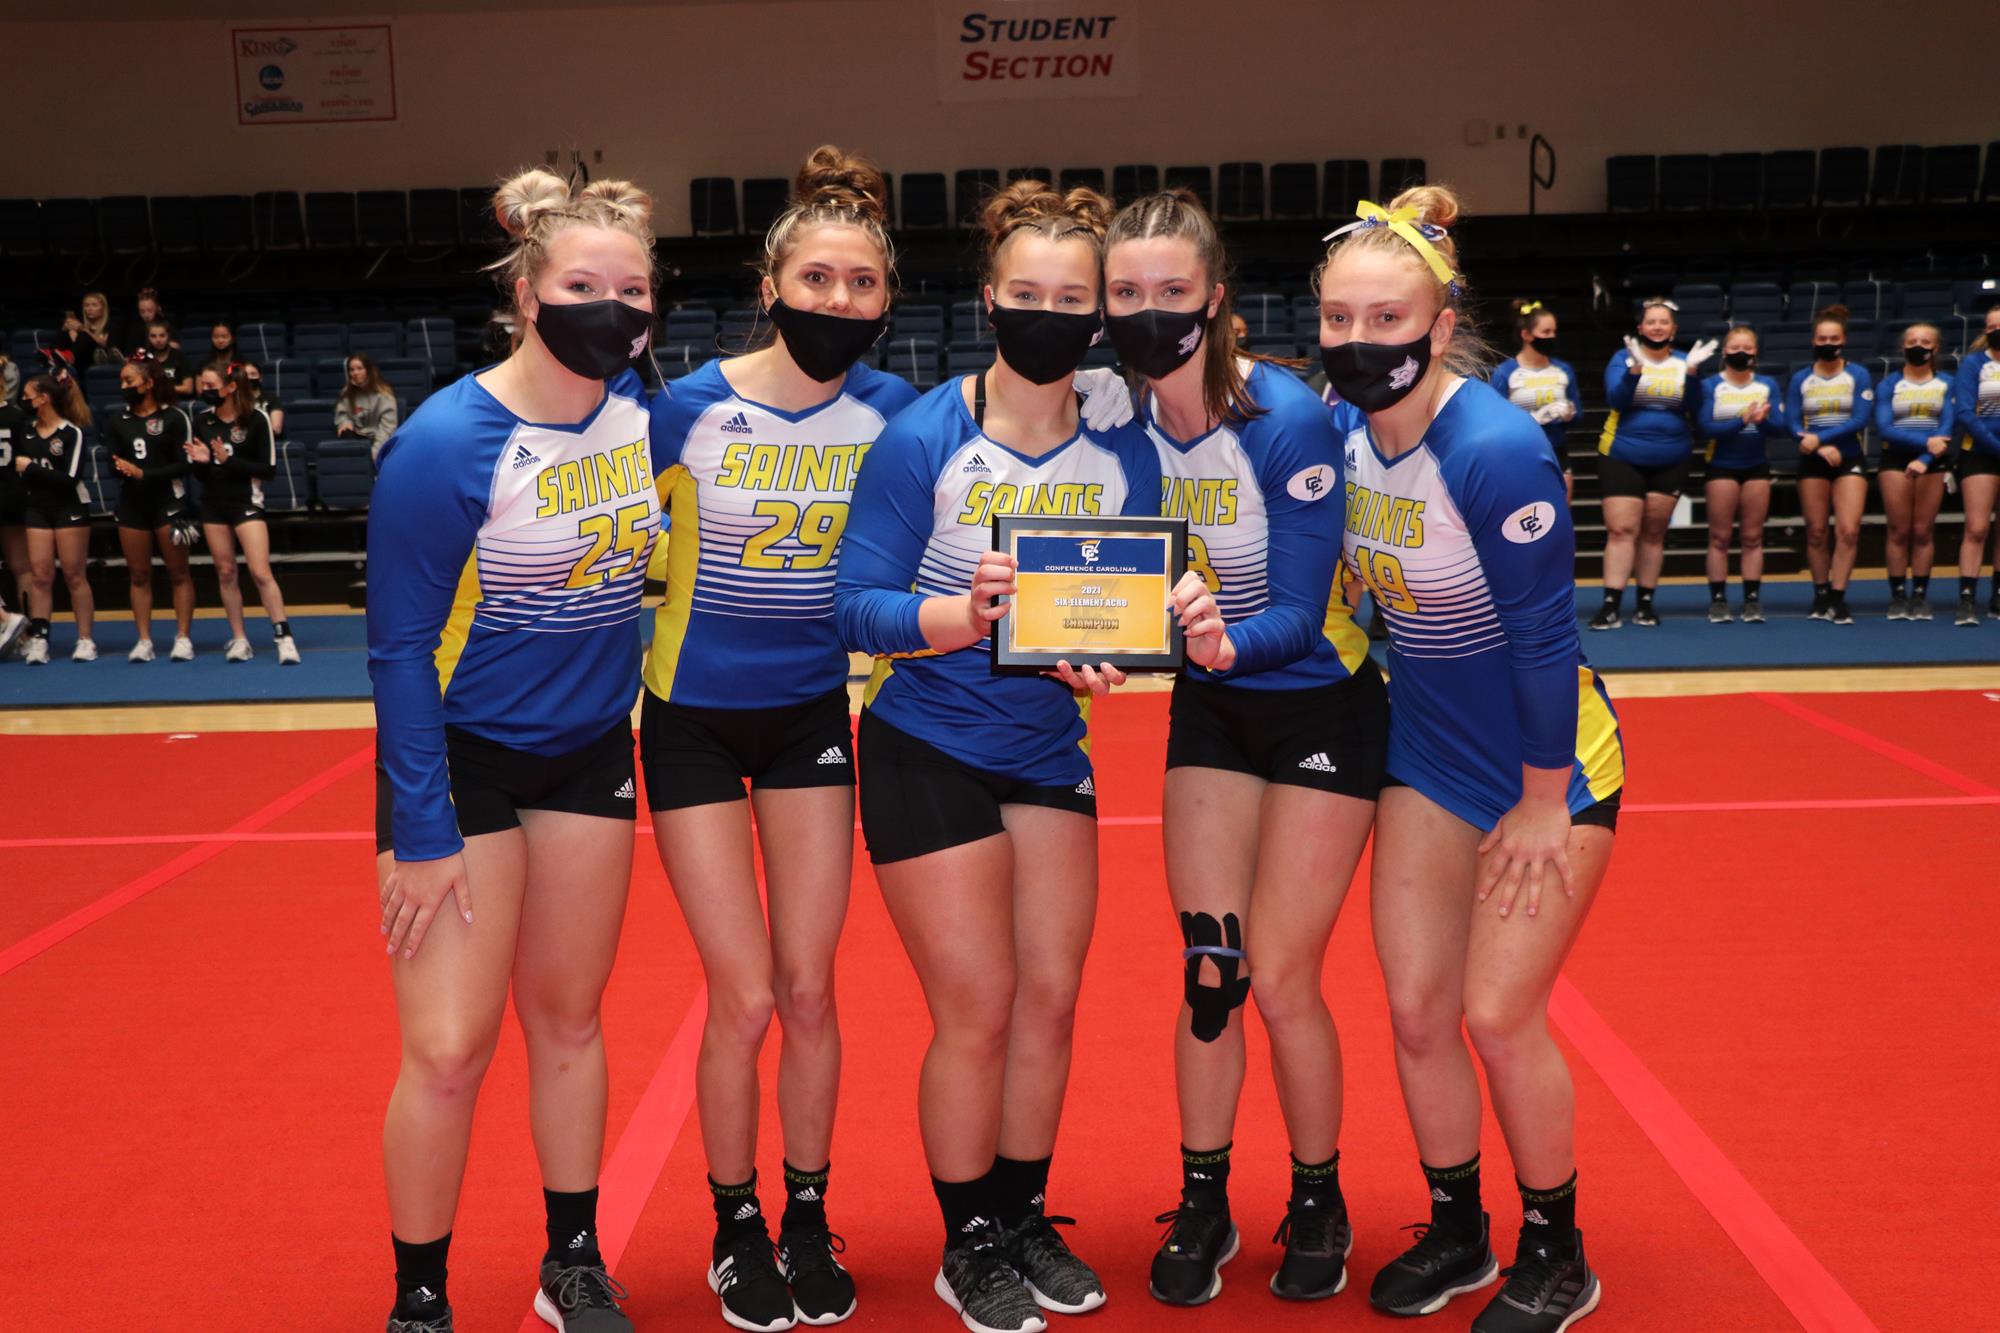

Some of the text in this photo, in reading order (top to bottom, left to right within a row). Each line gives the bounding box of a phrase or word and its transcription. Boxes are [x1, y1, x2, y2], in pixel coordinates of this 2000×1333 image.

[960, 14, 1116, 42] STUDENT
[963, 51, 1113, 80] SECTION
[720, 424, 752, 434] adidas
[133, 438, 147, 459] 9
[512, 454, 541, 470] adidas
[536, 438, 652, 519] SAINTS
[739, 500, 850, 570] 29
[563, 500, 650, 590] 25
[1354, 545, 1420, 614] 19
[1081, 586, 1102, 595] 2021
[1055, 598, 1129, 608] SIX-ELEMENT ACRO
[1063, 618, 1120, 630] CHAMPION
[817, 755, 847, 765] adidas
[1299, 760, 1337, 772] adidas
[796, 1192, 820, 1201] adidas
[734, 1207, 759, 1220] adidas
